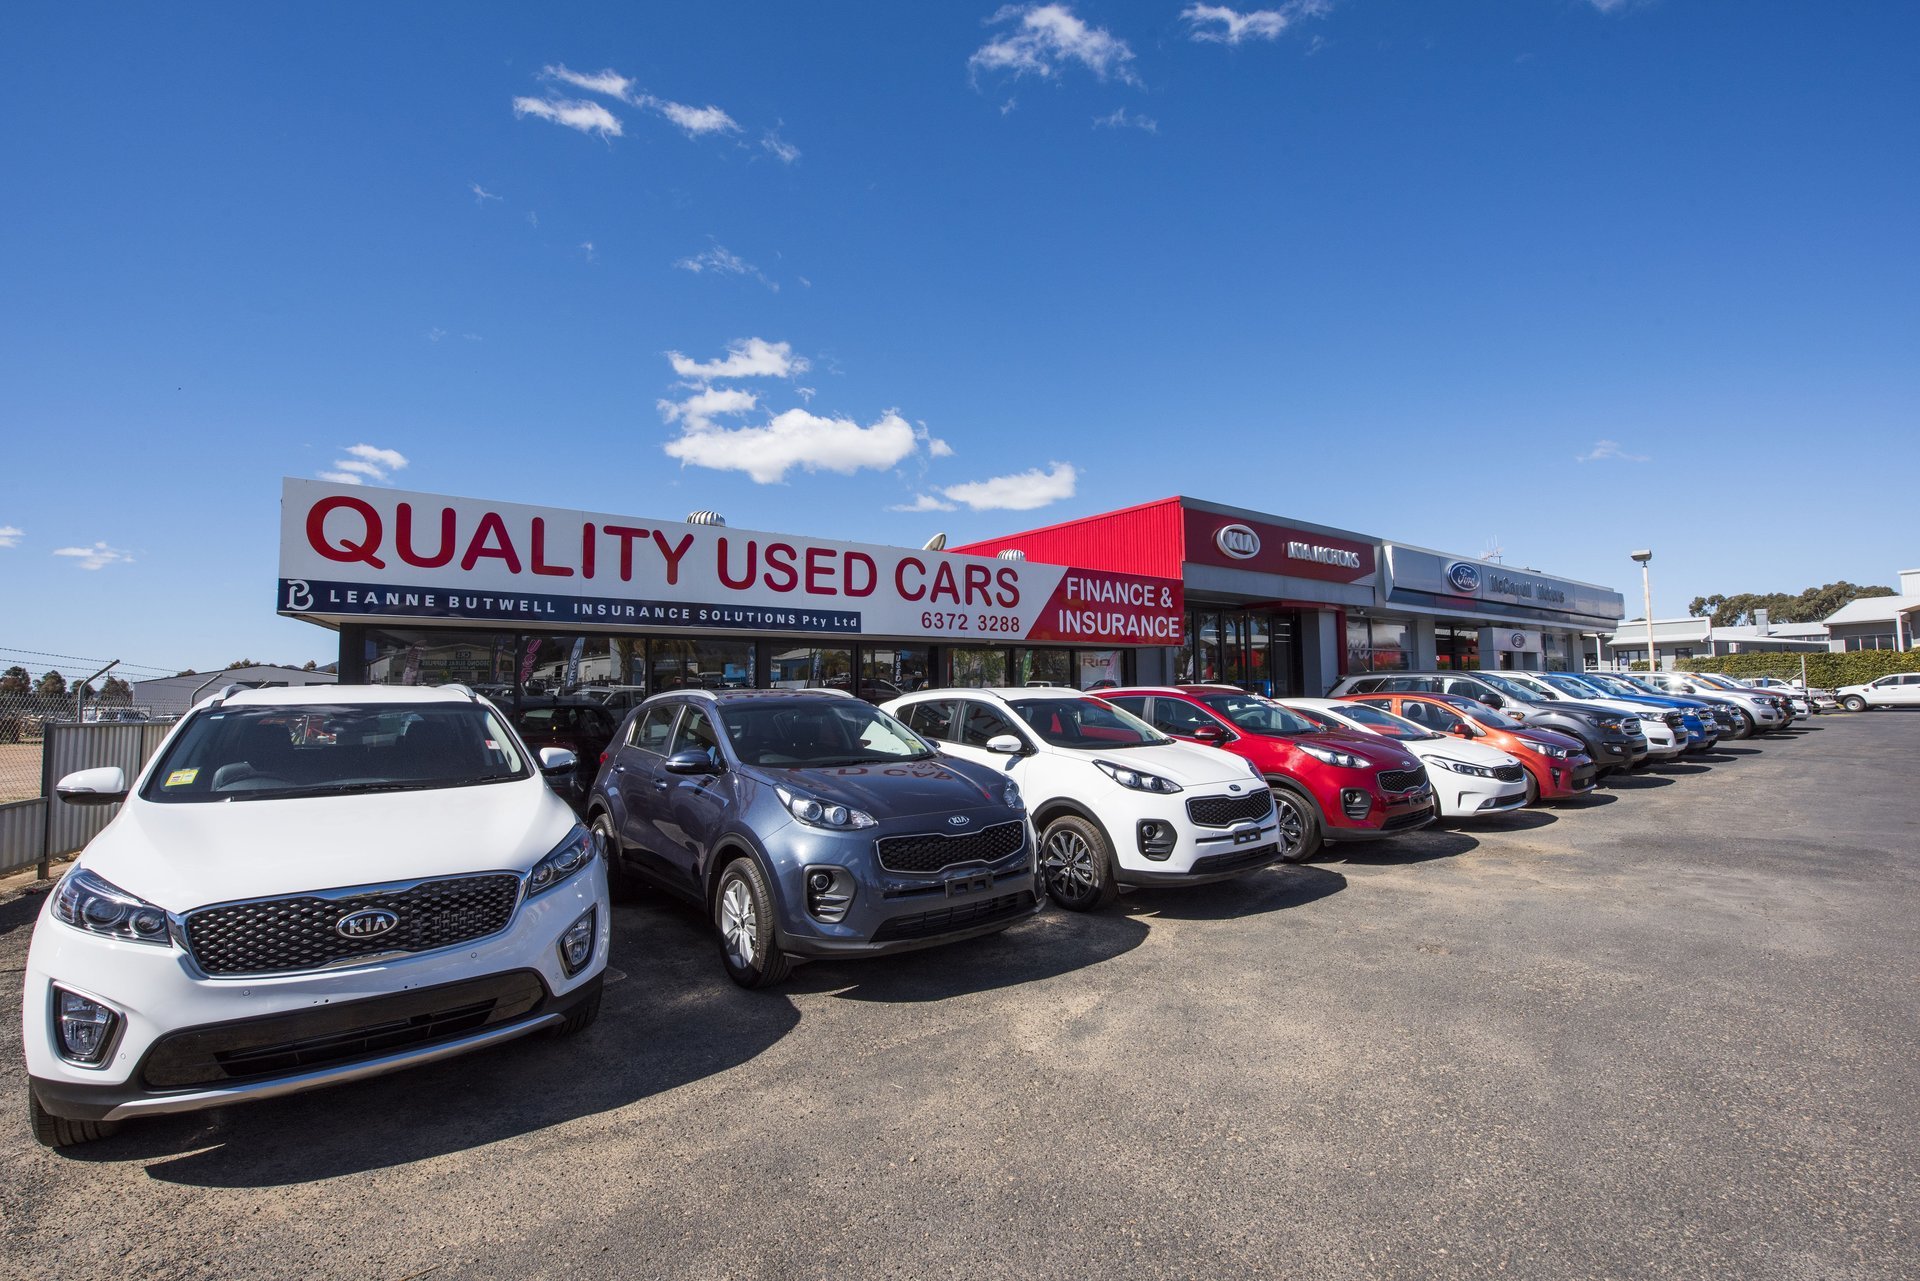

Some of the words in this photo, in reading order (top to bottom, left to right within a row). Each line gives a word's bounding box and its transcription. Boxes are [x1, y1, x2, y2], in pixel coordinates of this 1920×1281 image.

[306, 496, 694, 586] QUALITY
[717, 537, 877, 598] USED
[895, 557, 1020, 609] CARS
[1226, 531, 1254, 553] KIA
[1287, 541, 1312, 561] KIA
[1313, 545, 1360, 569] MOTORS
[1457, 567, 1476, 587] Ford
[1067, 577, 1155, 608] FINANCE
[1161, 587, 1173, 609] &
[330, 589, 435, 608] LEANNE
[449, 596, 556, 613] BUTWELL
[574, 603, 690, 619] INSURANCE
[699, 610, 796, 625] SOLUTIONS
[802, 614, 827, 628] Pty
[833, 611, 858, 627] Ltd
[921, 611, 968, 631] 6372
[977, 614, 1020, 633] 3288
[1058, 610, 1180, 638] INSURANCE
[348, 915, 388, 934] KIA
